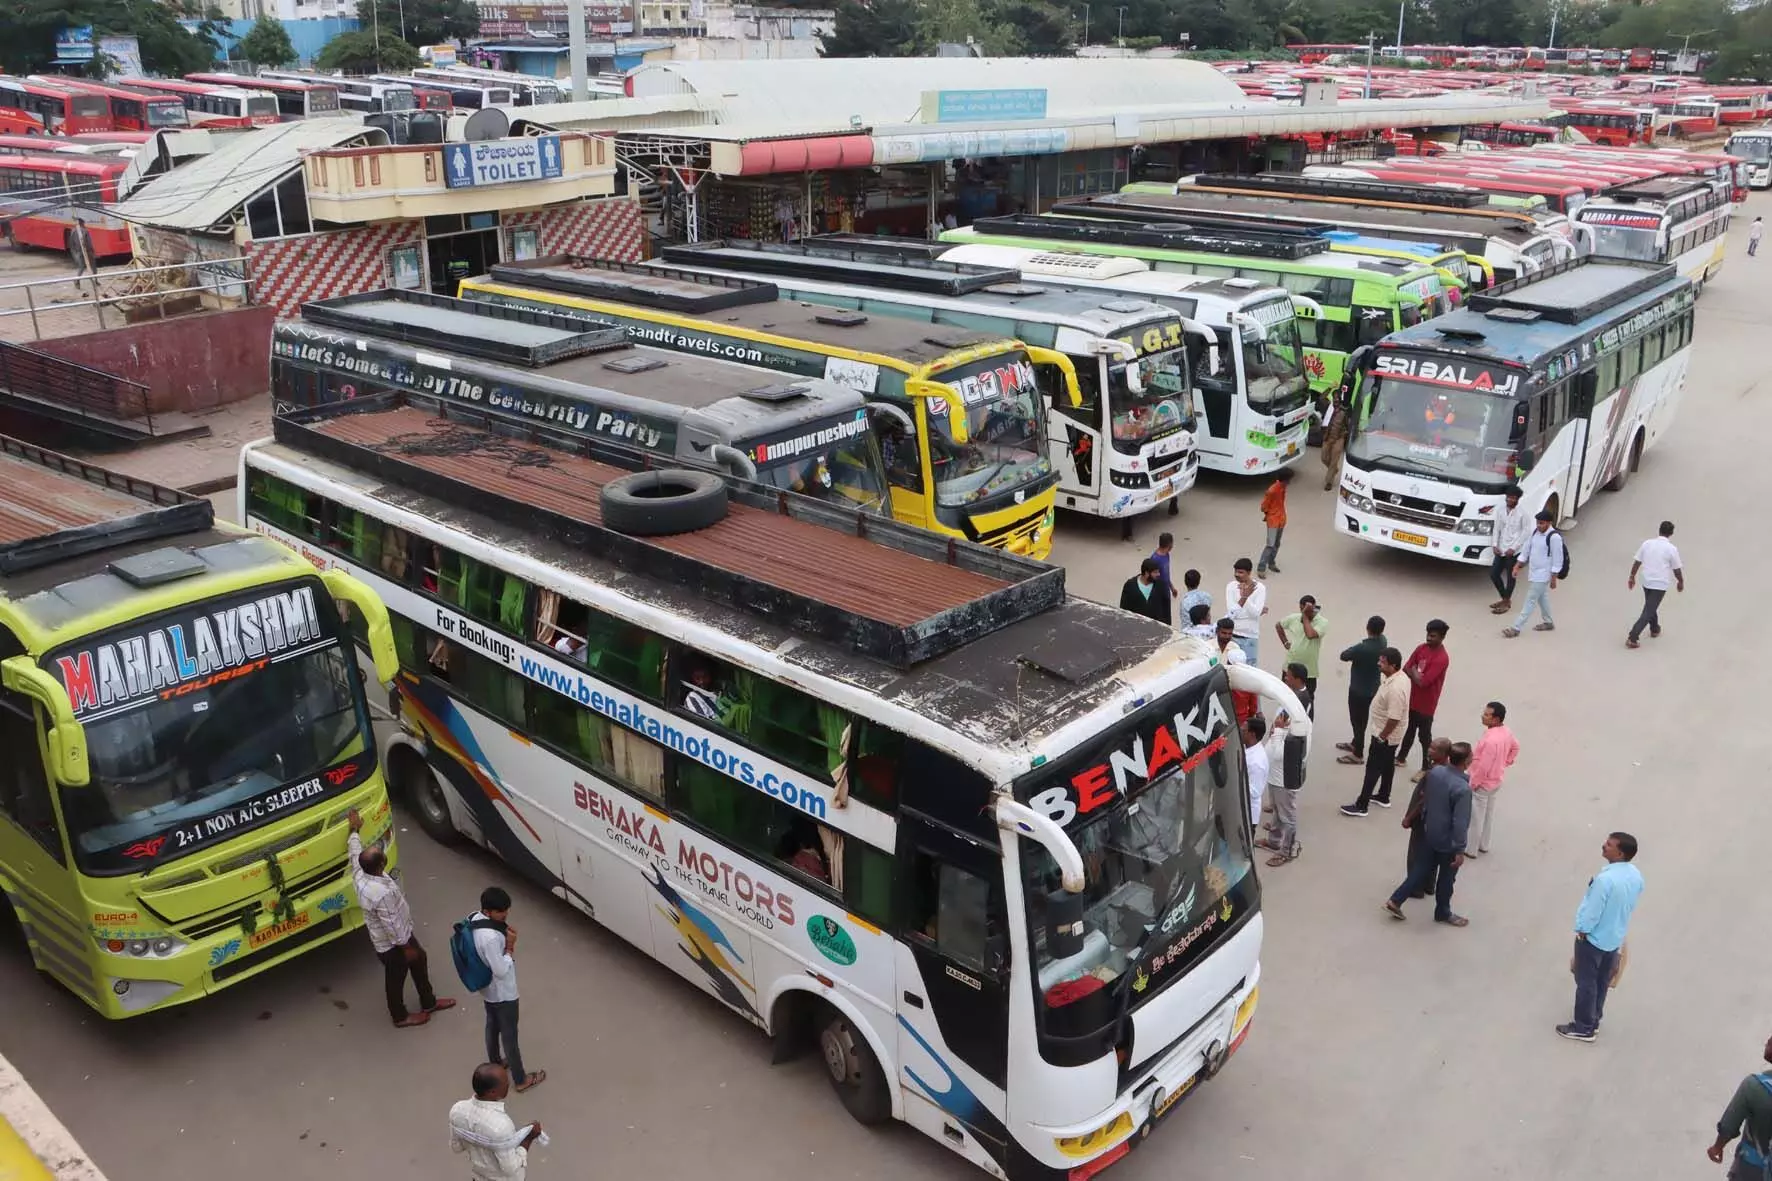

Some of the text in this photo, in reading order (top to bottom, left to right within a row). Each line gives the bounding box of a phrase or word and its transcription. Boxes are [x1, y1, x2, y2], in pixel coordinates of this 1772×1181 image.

[477, 160, 536, 182] TOILET
[301, 343, 332, 365] Let's
[335, 351, 380, 376] Come
[449, 376, 483, 400] The
[596, 411, 662, 448] Party
[1376, 356, 1416, 377] SRI
[1419, 361, 1519, 393] BALAJI
[57, 586, 321, 714] MAHALAKSHMI
[158, 657, 272, 701] TOURIST
[436, 609, 827, 820] For Booking: www.benakamotors.com
[1029, 691, 1230, 829] BENAKA
[175, 777, 324, 847] 2+1 NON A/C SLEEPER
[573, 780, 796, 926] BENAKA MOTORS
[94, 912, 138, 922] EURO-4
[606, 827, 774, 930] GATEWAY TO THE TRAVEL WORLD
